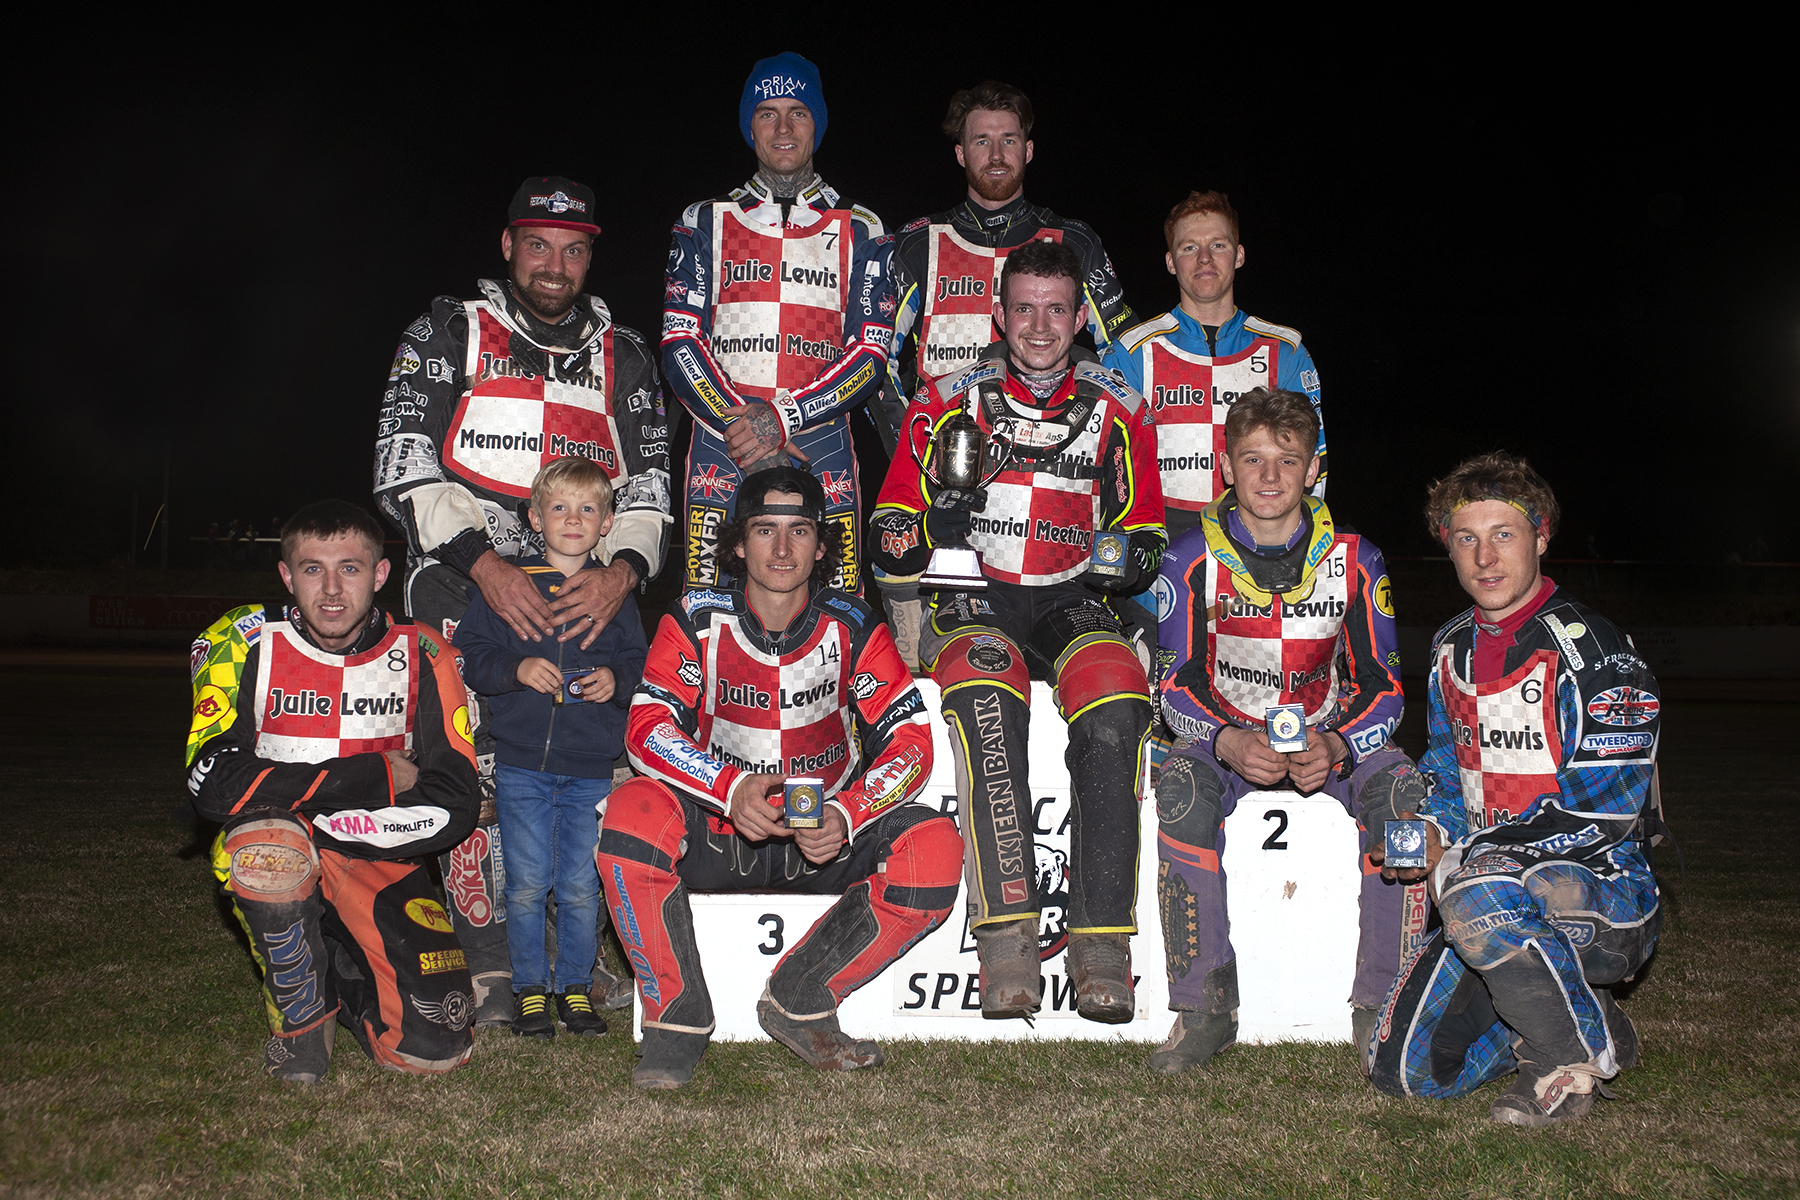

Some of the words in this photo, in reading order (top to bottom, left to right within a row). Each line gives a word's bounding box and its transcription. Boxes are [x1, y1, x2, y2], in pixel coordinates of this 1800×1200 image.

[755, 76, 806, 95] ADRIAN
[763, 85, 796, 99] FLUX
[821, 232, 838, 250] 7
[722, 259, 773, 289] Julie
[780, 260, 838, 289] Lewis
[938, 276, 986, 302] Julie
[860, 273, 875, 316] integro
[711, 333, 780, 354] Memorial
[677, 350, 701, 380] Allied
[1250, 355, 1267, 373] 5
[808, 392, 837, 414] Allied
[838, 363, 875, 402] Mobility
[1155, 385, 1204, 410] Julie
[460, 428, 544, 453] Memorial
[550, 434, 616, 468] Meeting
[1158, 452, 1215, 471] emorial
[687, 508, 704, 585] POWER
[699, 510, 721, 585] MAXED
[971, 517, 1030, 539] emorial
[1035, 520, 1092, 551] Meeting
[838, 514, 856, 593] POWER
[1326, 556, 1345, 579] 15
[97, 608, 135, 617] PRINT
[97, 616, 146, 626] DESIGN
[387, 649, 407, 672] 8
[818, 641, 840, 666] 14
[1217, 659, 1285, 692] Memorial
[270, 688, 333, 720] Julie
[340, 690, 405, 716] Lewis
[718, 679, 771, 711] Julie
[779, 678, 837, 710] Lewis
[1520, 679, 1542, 704] 6
[973, 691, 1010, 777] BANK
[1478, 723, 1544, 751] Lewis
[1587, 734, 1649, 747] TWEEDSIDE
[644, 735, 715, 789] Powdercoating
[711, 742, 784, 775] Memorial
[790, 741, 846, 777] Meeting
[850, 778, 886, 811] ROOF
[883, 744, 923, 780] TILER
[329, 815, 379, 835] KMA
[383, 818, 435, 833] FORKLIFTS
[1262, 809, 1288, 850] 2
[454, 827, 492, 927] SYKES
[613, 863, 645, 948] FABRICATION
[615, 905, 633, 946] STEEL
[757, 913, 785, 955] 3
